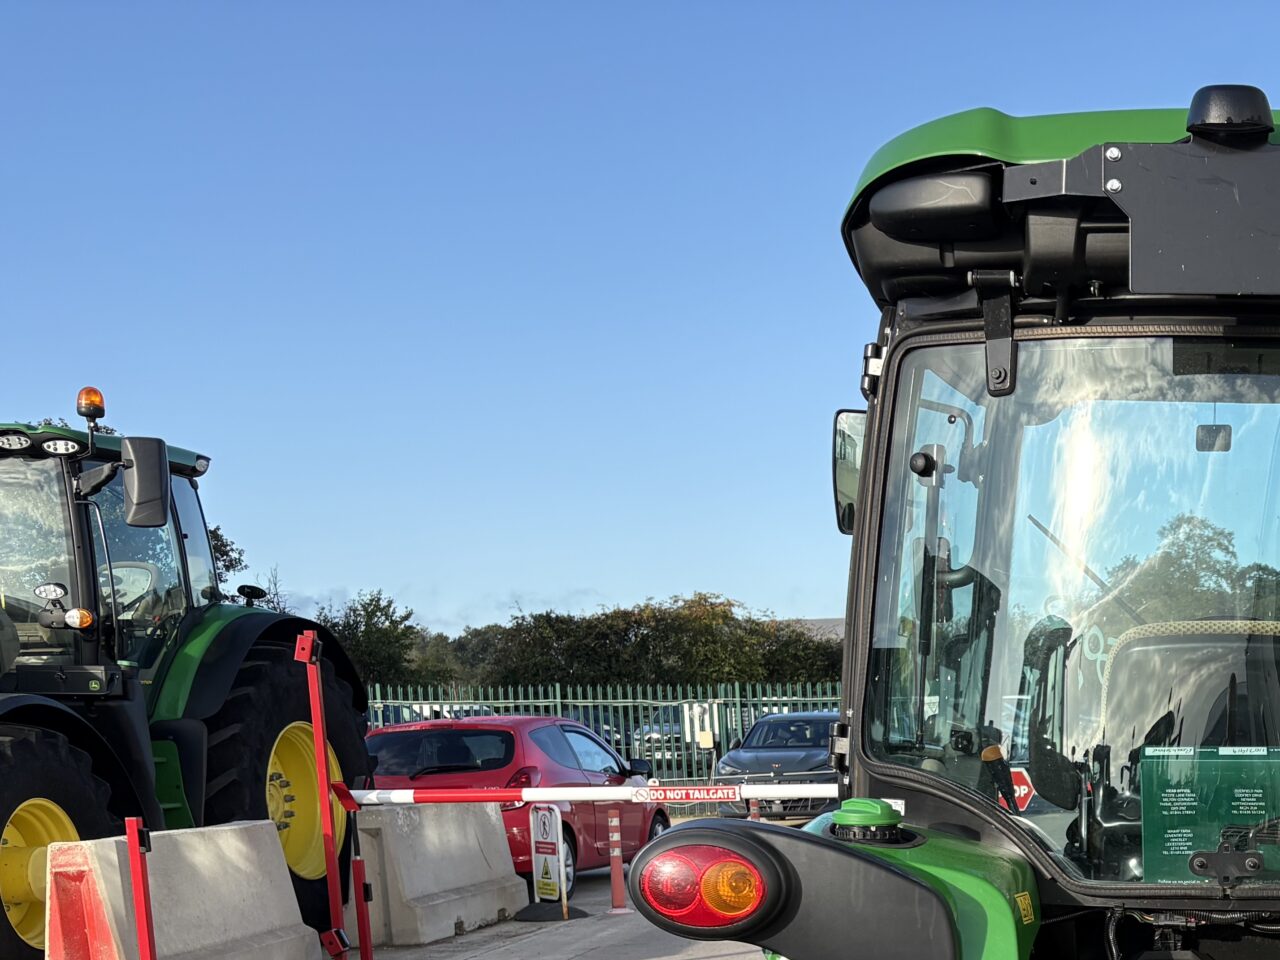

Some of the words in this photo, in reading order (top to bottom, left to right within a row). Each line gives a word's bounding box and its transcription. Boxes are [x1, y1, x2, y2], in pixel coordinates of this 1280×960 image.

[650, 789, 665, 800] DO
[666, 789, 687, 799] NOT
[687, 789, 736, 799] TAILGATE
